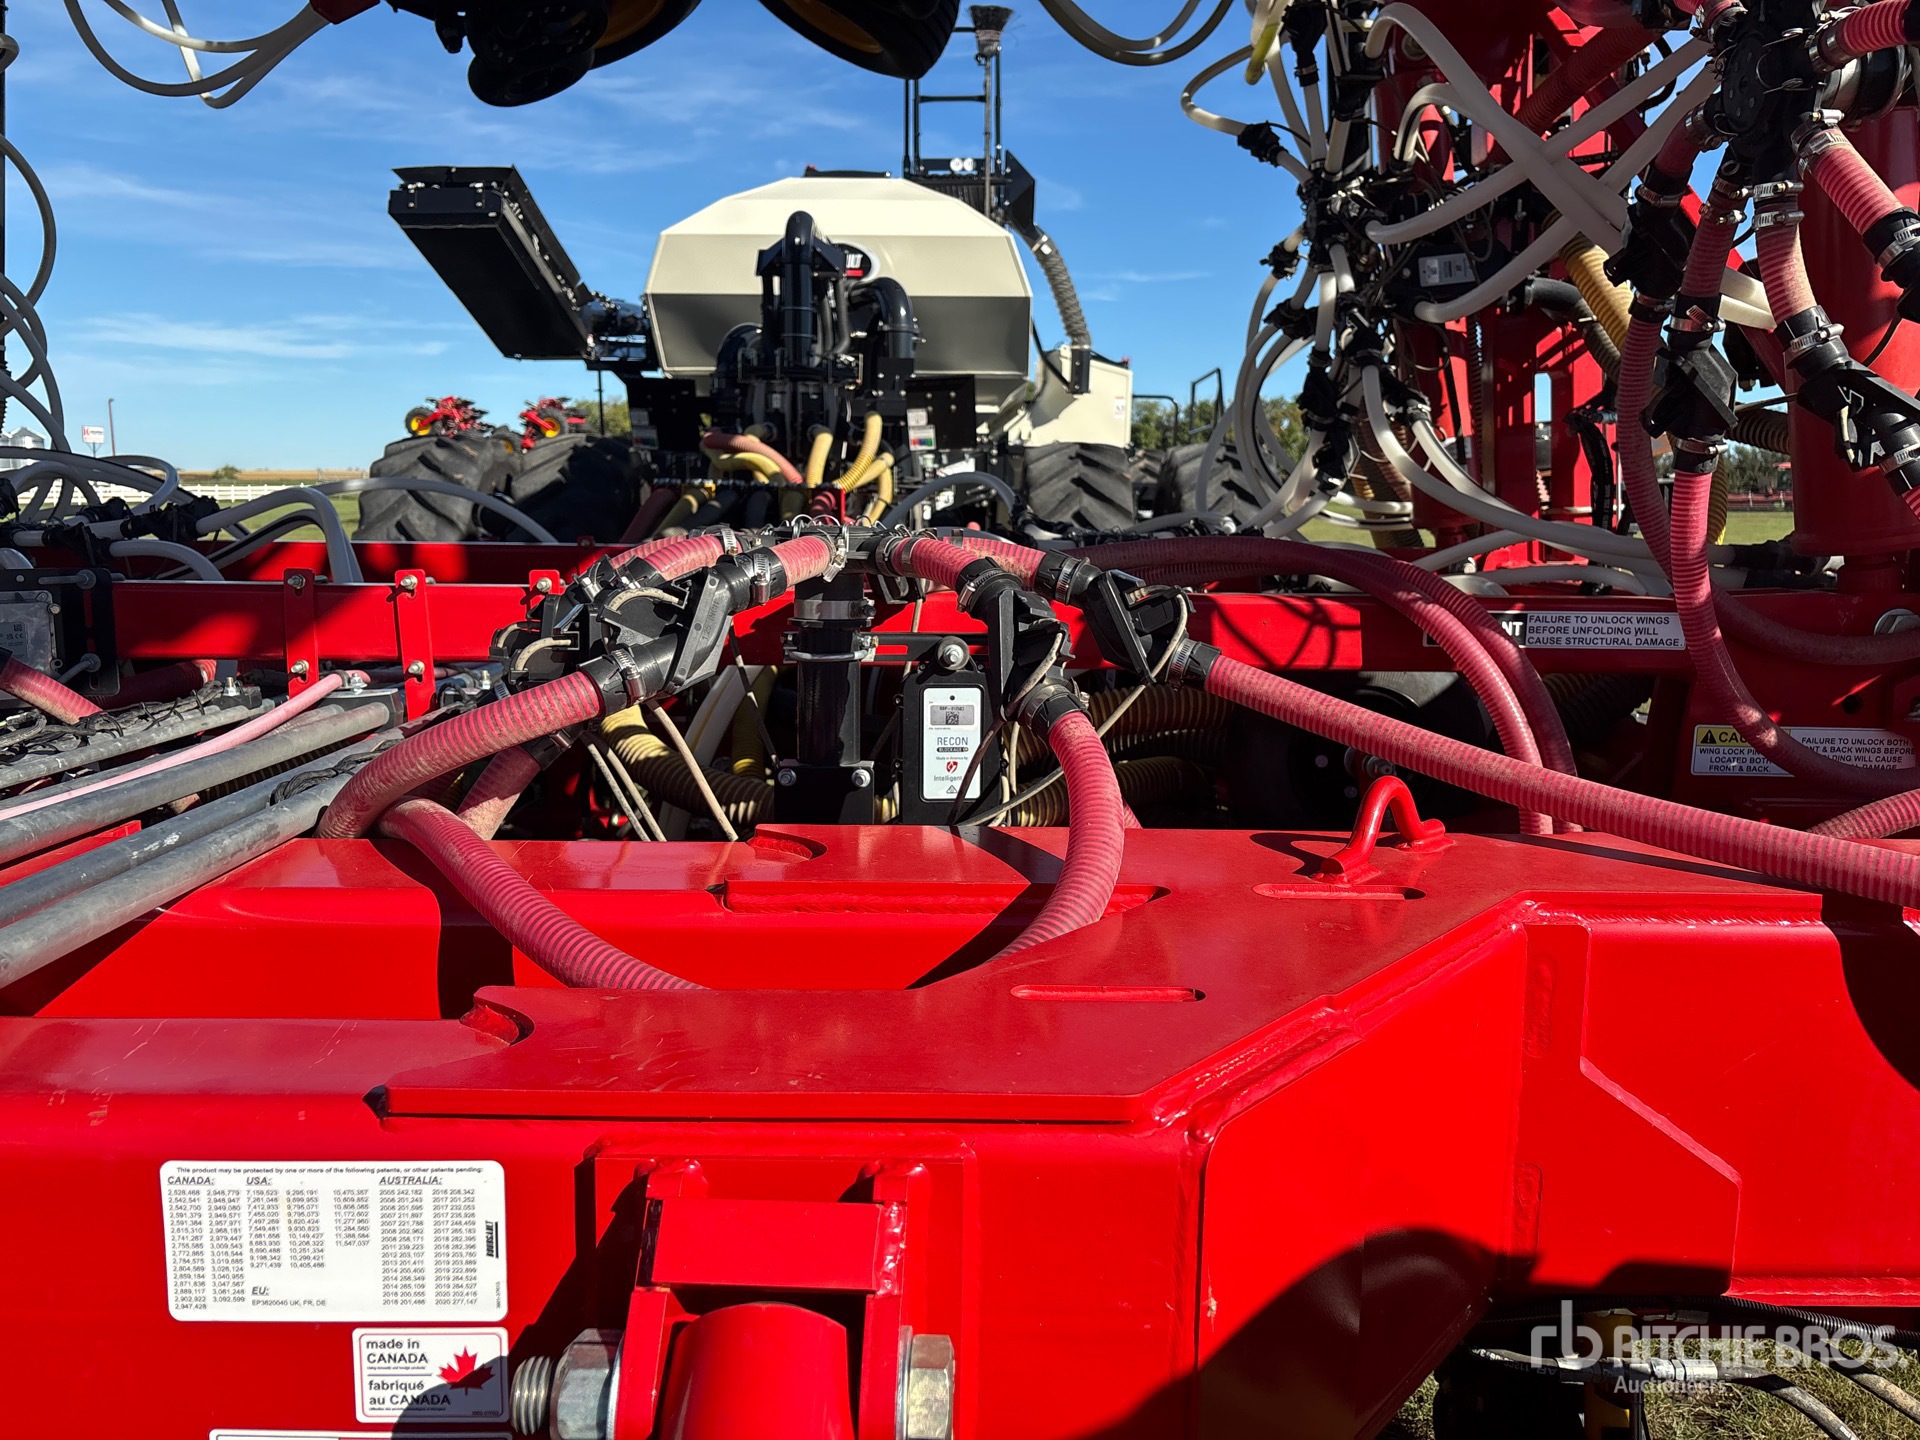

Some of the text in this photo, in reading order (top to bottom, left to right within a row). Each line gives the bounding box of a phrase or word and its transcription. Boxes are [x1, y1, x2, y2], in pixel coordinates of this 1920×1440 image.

[1528, 615, 1670, 625] FAILURE TO UNLOCK WINGS
[1528, 626, 1569, 634] BEFORE
[1572, 626, 1632, 635] UNFOLDING
[1634, 627, 1658, 635] WILL
[1528, 636, 1682, 647] CAUSE STRUCTURAL DAMAGE.
[937, 737, 968, 745] RECON
[168, 1176, 214, 1185] CANADA:
[246, 1176, 272, 1185] USA:
[379, 1176, 443, 1185] AUSTRALIA:
[252, 1286, 270, 1295] EU:
[366, 1339, 420, 1349] made in
[367, 1353, 428, 1364] CANADA
[368, 1380, 424, 1393] fabriqué
[369, 1394, 451, 1405] au CANADA
